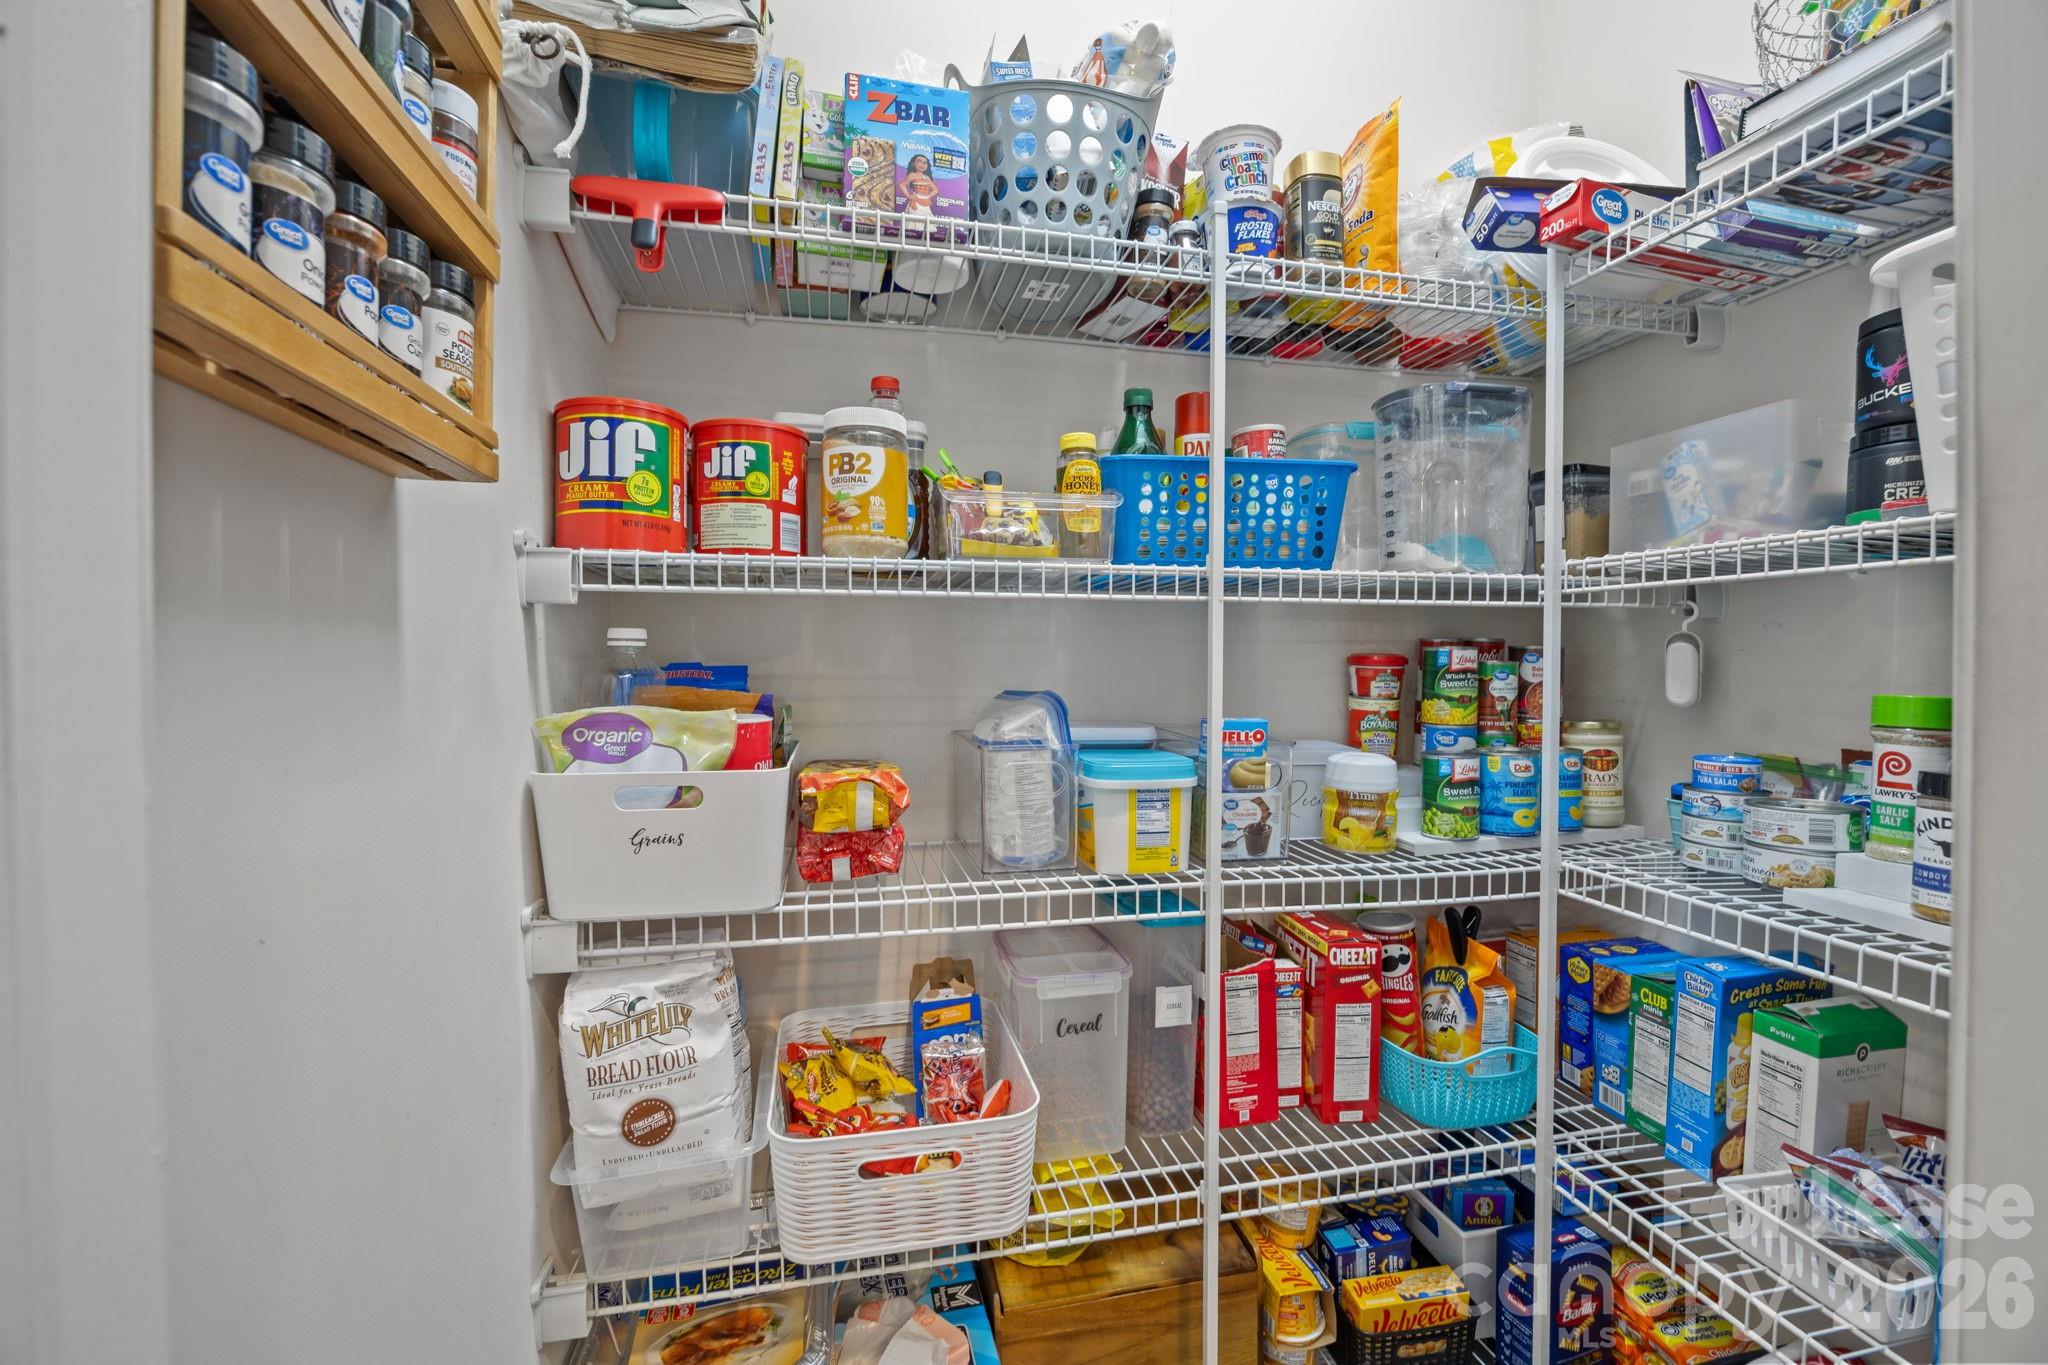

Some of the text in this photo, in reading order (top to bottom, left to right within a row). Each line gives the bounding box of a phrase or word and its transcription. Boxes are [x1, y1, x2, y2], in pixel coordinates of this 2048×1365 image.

[995, 66, 1031, 77] SWISS MISS
[786, 72, 802, 106] CAMO
[849, 73, 860, 99] CLIF
[753, 143, 768, 184] PAAS
[781, 140, 795, 182] PAAS
[1224, 172, 1268, 192] Crunch
[1595, 194, 1623, 212] Great
[1316, 211, 1340, 221] GOLD
[1602, 206, 1623, 218] Value
[1234, 220, 1274, 234] FROSTED
[1347, 209, 1375, 233] Soda
[1237, 229, 1272, 241] FLAKES
[1476, 223, 1489, 243] 50
[1541, 218, 1565, 240] 200
[559, 419, 657, 481] Jif
[703, 445, 757, 479] Jif
[828, 451, 873, 477] PB2
[830, 475, 869, 484] ORIGINAL
[1064, 481, 1100, 491] HONEY
[568, 483, 609, 492] CREAMY
[633, 483, 656, 495] PROTEIN
[565, 491, 616, 499] PEANUT BUTTER
[1439, 680, 1467, 689] Sweet
[572, 727, 643, 747] Organic
[1436, 734, 1455, 742] Great
[603, 743, 627, 754] Great
[1514, 763, 1533, 772] Dole
[1566, 760, 1579, 768] Dole
[1696, 763, 1720, 772] BUMBLE
[1584, 772, 1619, 783] RAO'S
[1697, 775, 1738, 786] TUNA SALAD
[1443, 786, 1472, 796] Sweet
[1513, 788, 1532, 797] SLICES
[1874, 787, 1917, 800] LAWRY'S
[1876, 805, 1909, 818] GARLIC
[1879, 815, 1903, 827] SALT
[628, 828, 685, 855] Grains
[1914, 867, 1948, 880] COWBOY
[1569, 960, 1588, 975] Honey
[1569, 967, 1586, 980] Maid
[1339, 973, 1371, 985] ORIGINAL
[1684, 971, 1713, 991] Chicken
[1686, 980, 1710, 998] Biskit
[1730, 976, 1828, 1005] Create Some Fun
[1640, 987, 1668, 1010] CLUB
[1166, 1002, 1183, 1010] CEREAL
[1643, 1003, 1663, 1017] minis
[1700, 1001, 1715, 1013] Facts
[1421, 1003, 1459, 1025] Goldfish
[579, 1002, 695, 1059] WHITE LILY
[1056, 1012, 1104, 1038] Cereal
[1655, 1023, 1671, 1034] Facts
[1769, 1026, 1796, 1042] Publix
[1656, 1040, 1670, 1049] 140
[585, 1045, 699, 1088] BREAD FLOUR
[1760, 1049, 1803, 1072] Nutrition Facts
[1759, 1067, 1803, 1091] Calories 70
[591, 1072, 697, 1101] Ideal for Yeast Breads
[630, 1111, 665, 1131] UNBLEACHED
[602, 1140, 704, 1166] ENRICHED UNBLEACHED
[1464, 1214, 1502, 1227] Annie's
[1353, 1274, 1403, 1298] Velveeta
[1562, 1301, 1597, 1323] Barilla
